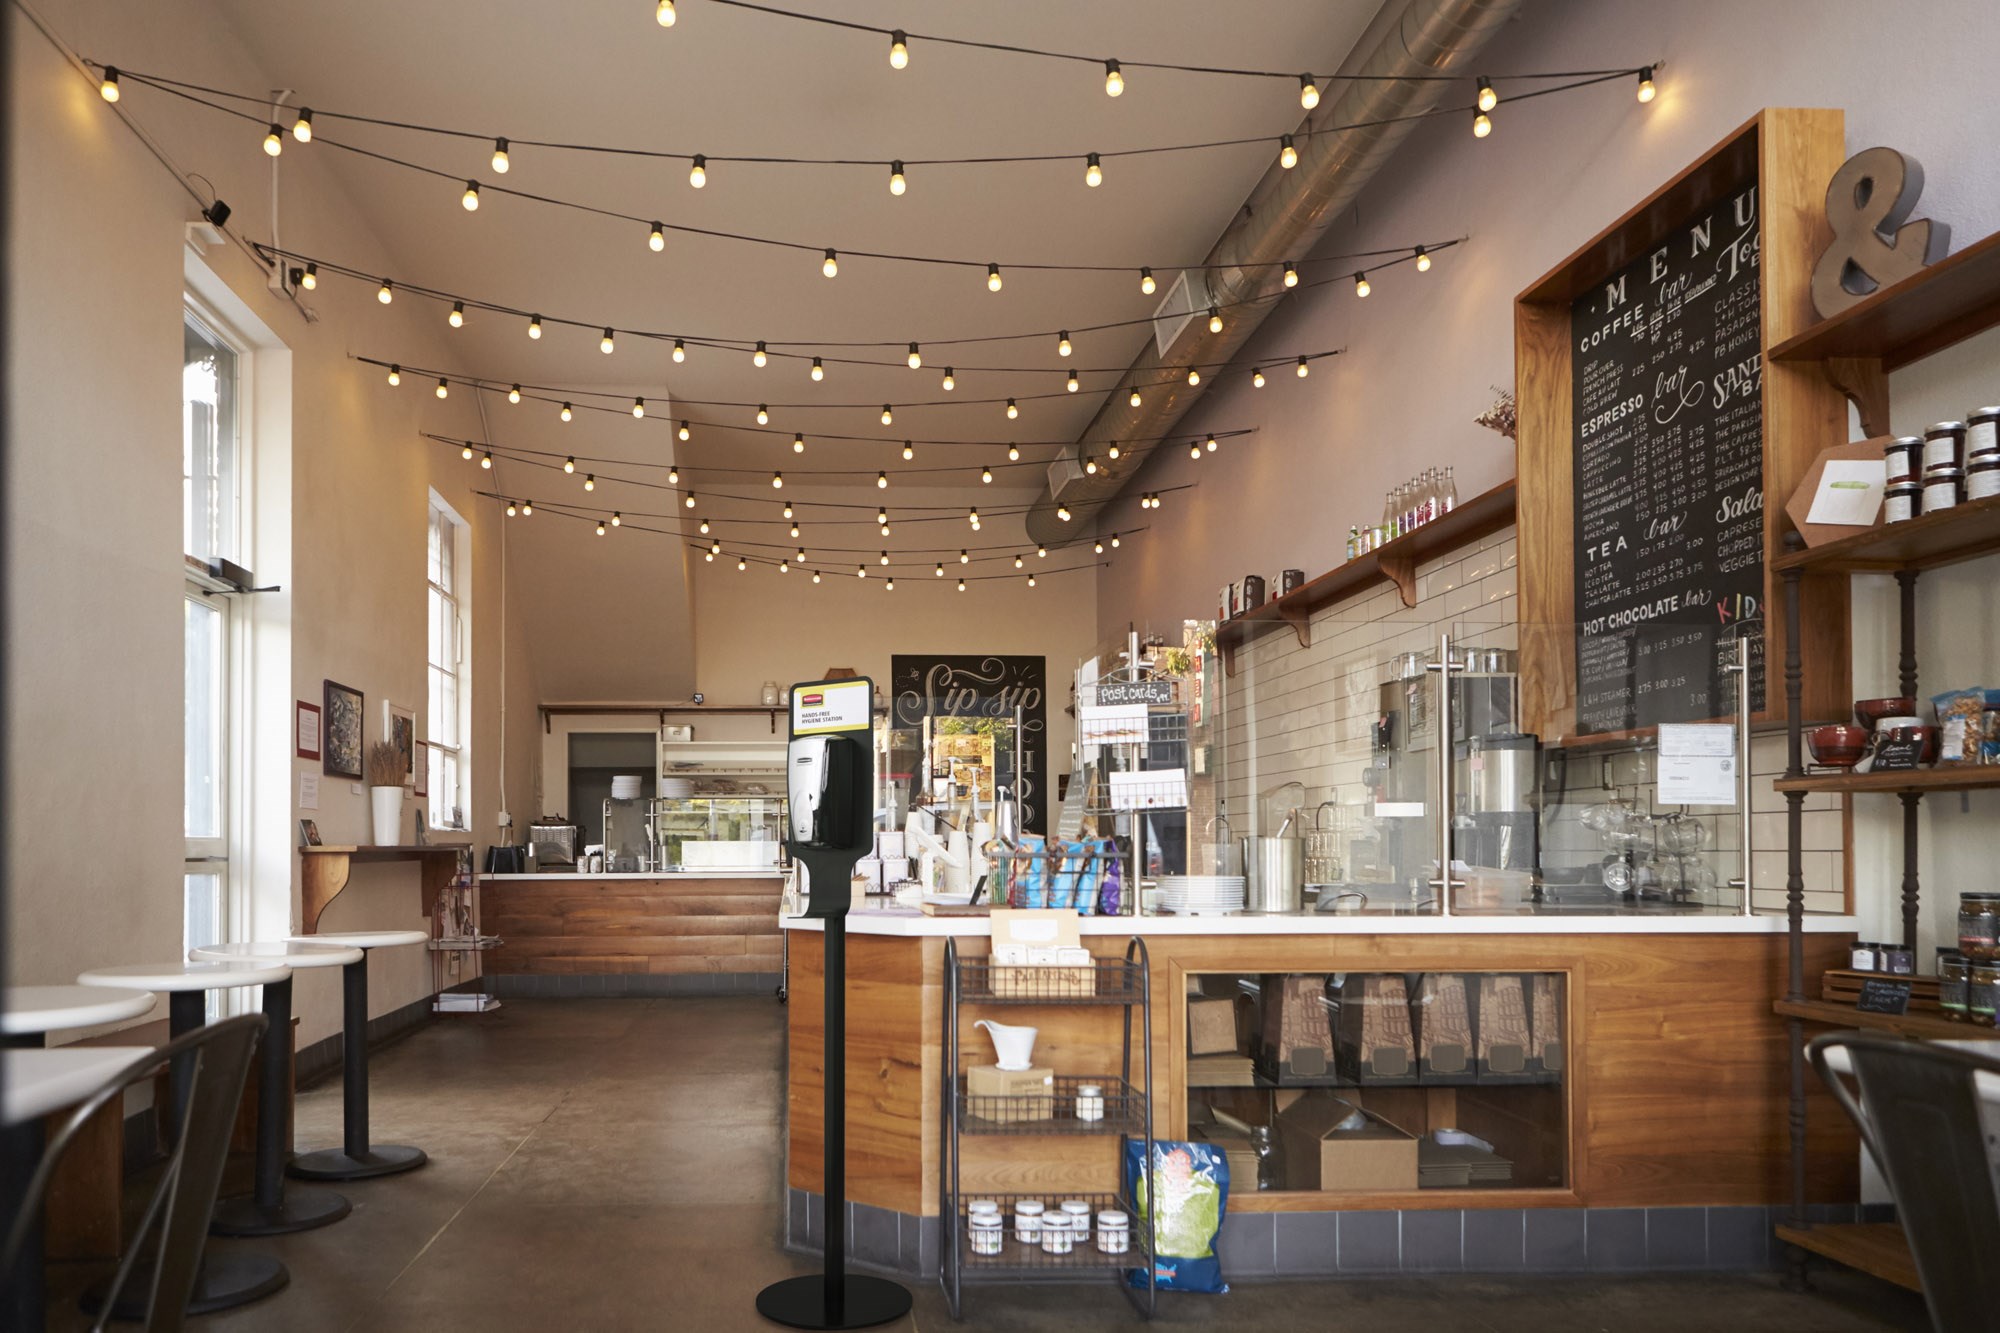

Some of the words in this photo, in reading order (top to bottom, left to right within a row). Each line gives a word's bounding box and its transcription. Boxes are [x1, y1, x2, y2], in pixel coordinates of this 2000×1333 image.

[1606, 186, 1757, 314] MENU
[1581, 303, 1643, 353] COFFEE
[1655, 271, 1692, 306] bar
[1581, 394, 1644, 438] ESPRESSO
[1651, 365, 1705, 424] bar
[1583, 475, 1603, 490] LATTE
[1587, 535, 1628, 562] TEA
[1643, 510, 1688, 540] bar
[1717, 536, 1754, 557] CHOPPED
[1584, 566, 1597, 578] HOT
[1599, 561, 1613, 573] TEA
[1719, 553, 1755, 573] VEGGIE
[1584, 577, 1600, 589] ICED
[1601, 571, 1614, 583] TEA
[1585, 588, 1598, 599] TEA
[1599, 580, 1620, 594] LATTE
[1583, 616, 1606, 637] HOT
[1608, 595, 1679, 629] CHOCOLATE
[1681, 588, 1713, 608] bar
[897, 662, 982, 725] Sip
[982, 681, 1042, 718] sip
[1600, 687, 1632, 704] STEAMER
